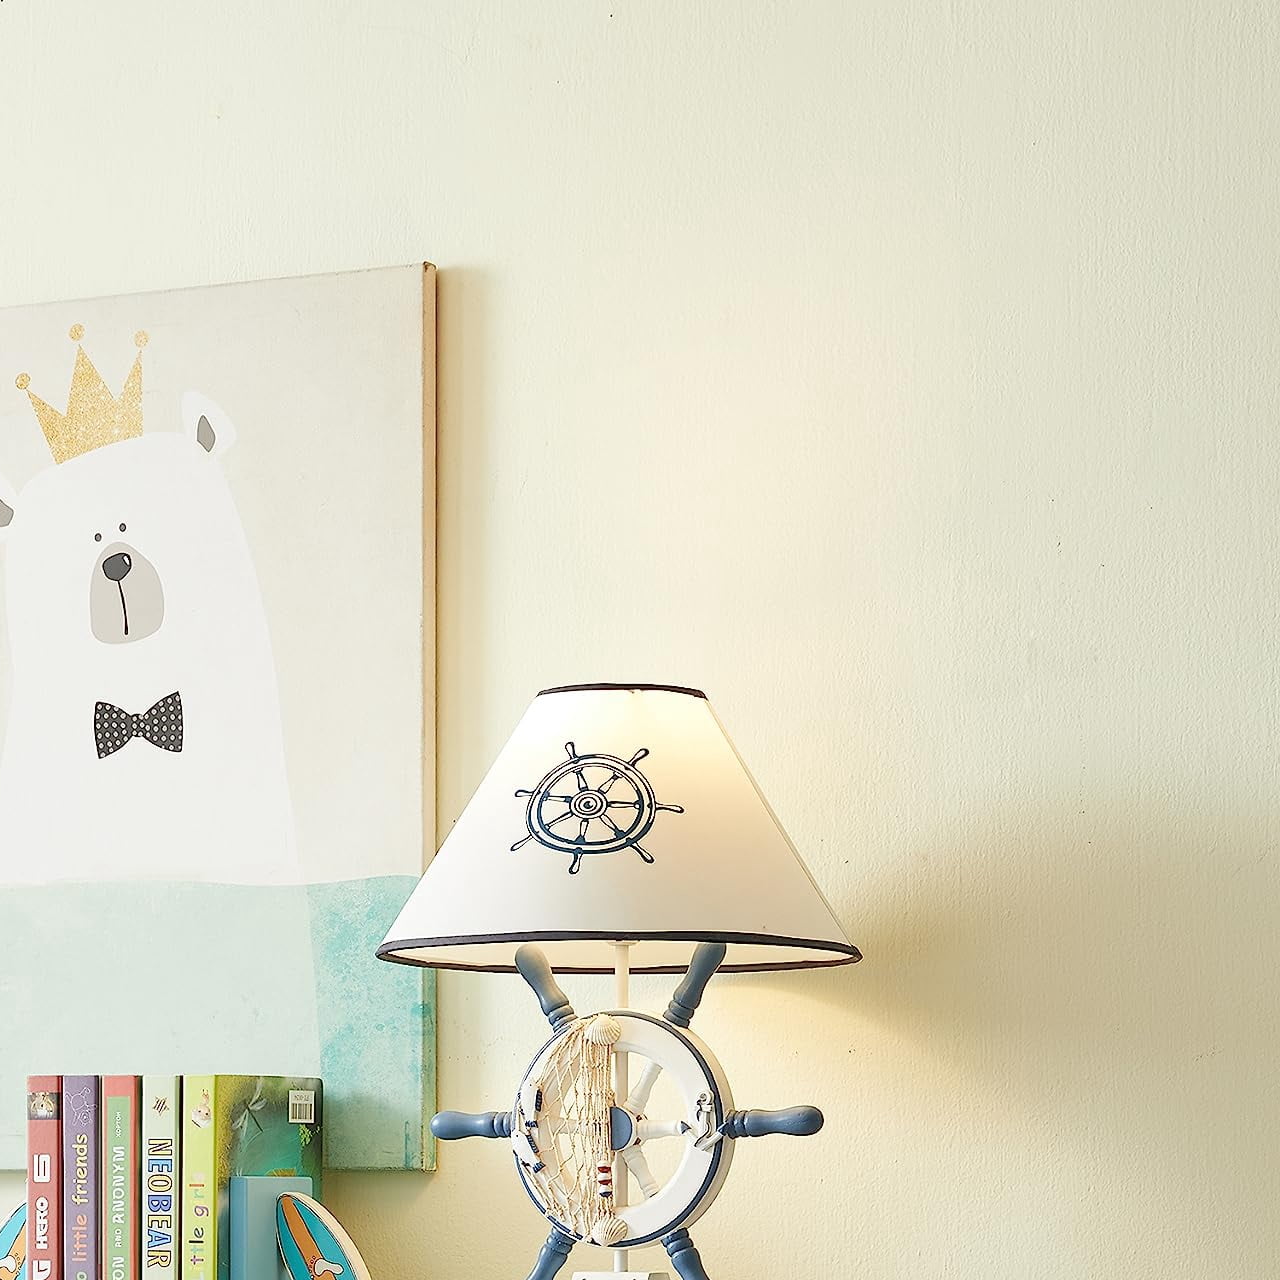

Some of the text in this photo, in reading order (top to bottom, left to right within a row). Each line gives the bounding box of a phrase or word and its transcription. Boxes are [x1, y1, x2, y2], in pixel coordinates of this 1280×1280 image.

[72, 1133, 89, 1205] friends
[111, 1146, 126, 1224] ANONYM
[35, 1196, 50, 1250] HERO
[147, 1138, 173, 1268] NEOBEAR
[72, 1213, 88, 1262] little
[114, 1229, 122, 1248] AND
